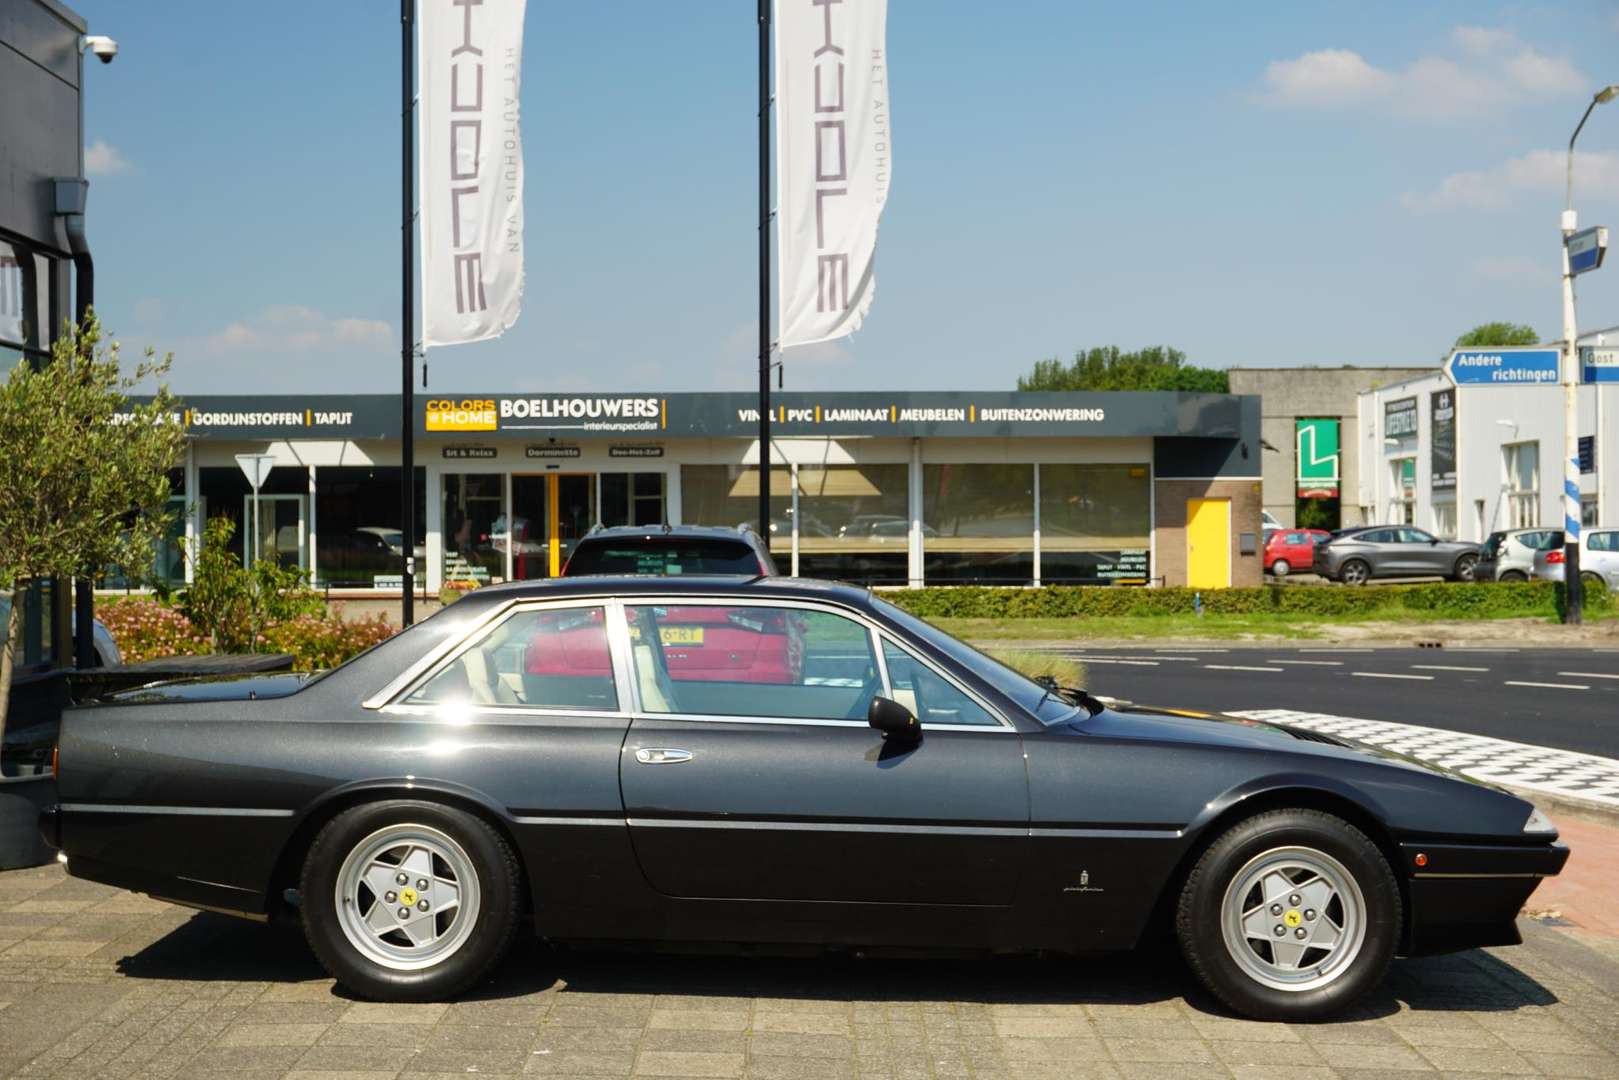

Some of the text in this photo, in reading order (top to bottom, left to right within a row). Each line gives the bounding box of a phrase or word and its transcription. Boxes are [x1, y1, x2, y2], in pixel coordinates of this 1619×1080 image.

[871, 48, 887, 205] HET AUTOHUIS
[503, 48, 519, 253] HET AUTOHUIS VAN
[1458, 354, 1503, 367] Andere
[1587, 353, 1614, 364] Oost
[1492, 368, 1556, 382] richtingen
[426, 399, 496, 411] COLORS
[500, 398, 659, 418] BOELHOUWERS
[193, 411, 303, 426] GORDIJNSTOFFEN
[314, 411, 353, 425] TAPIJT
[442, 411, 496, 424] HOME
[738, 408, 777, 422] VINL
[788, 409, 813, 422] PVC
[825, 409, 889, 422] LAMINAAT
[900, 409, 965, 422] MEUBELEN
[981, 408, 1104, 422] BUITENZONWERING
[583, 421, 658, 432] interieurspecialist
